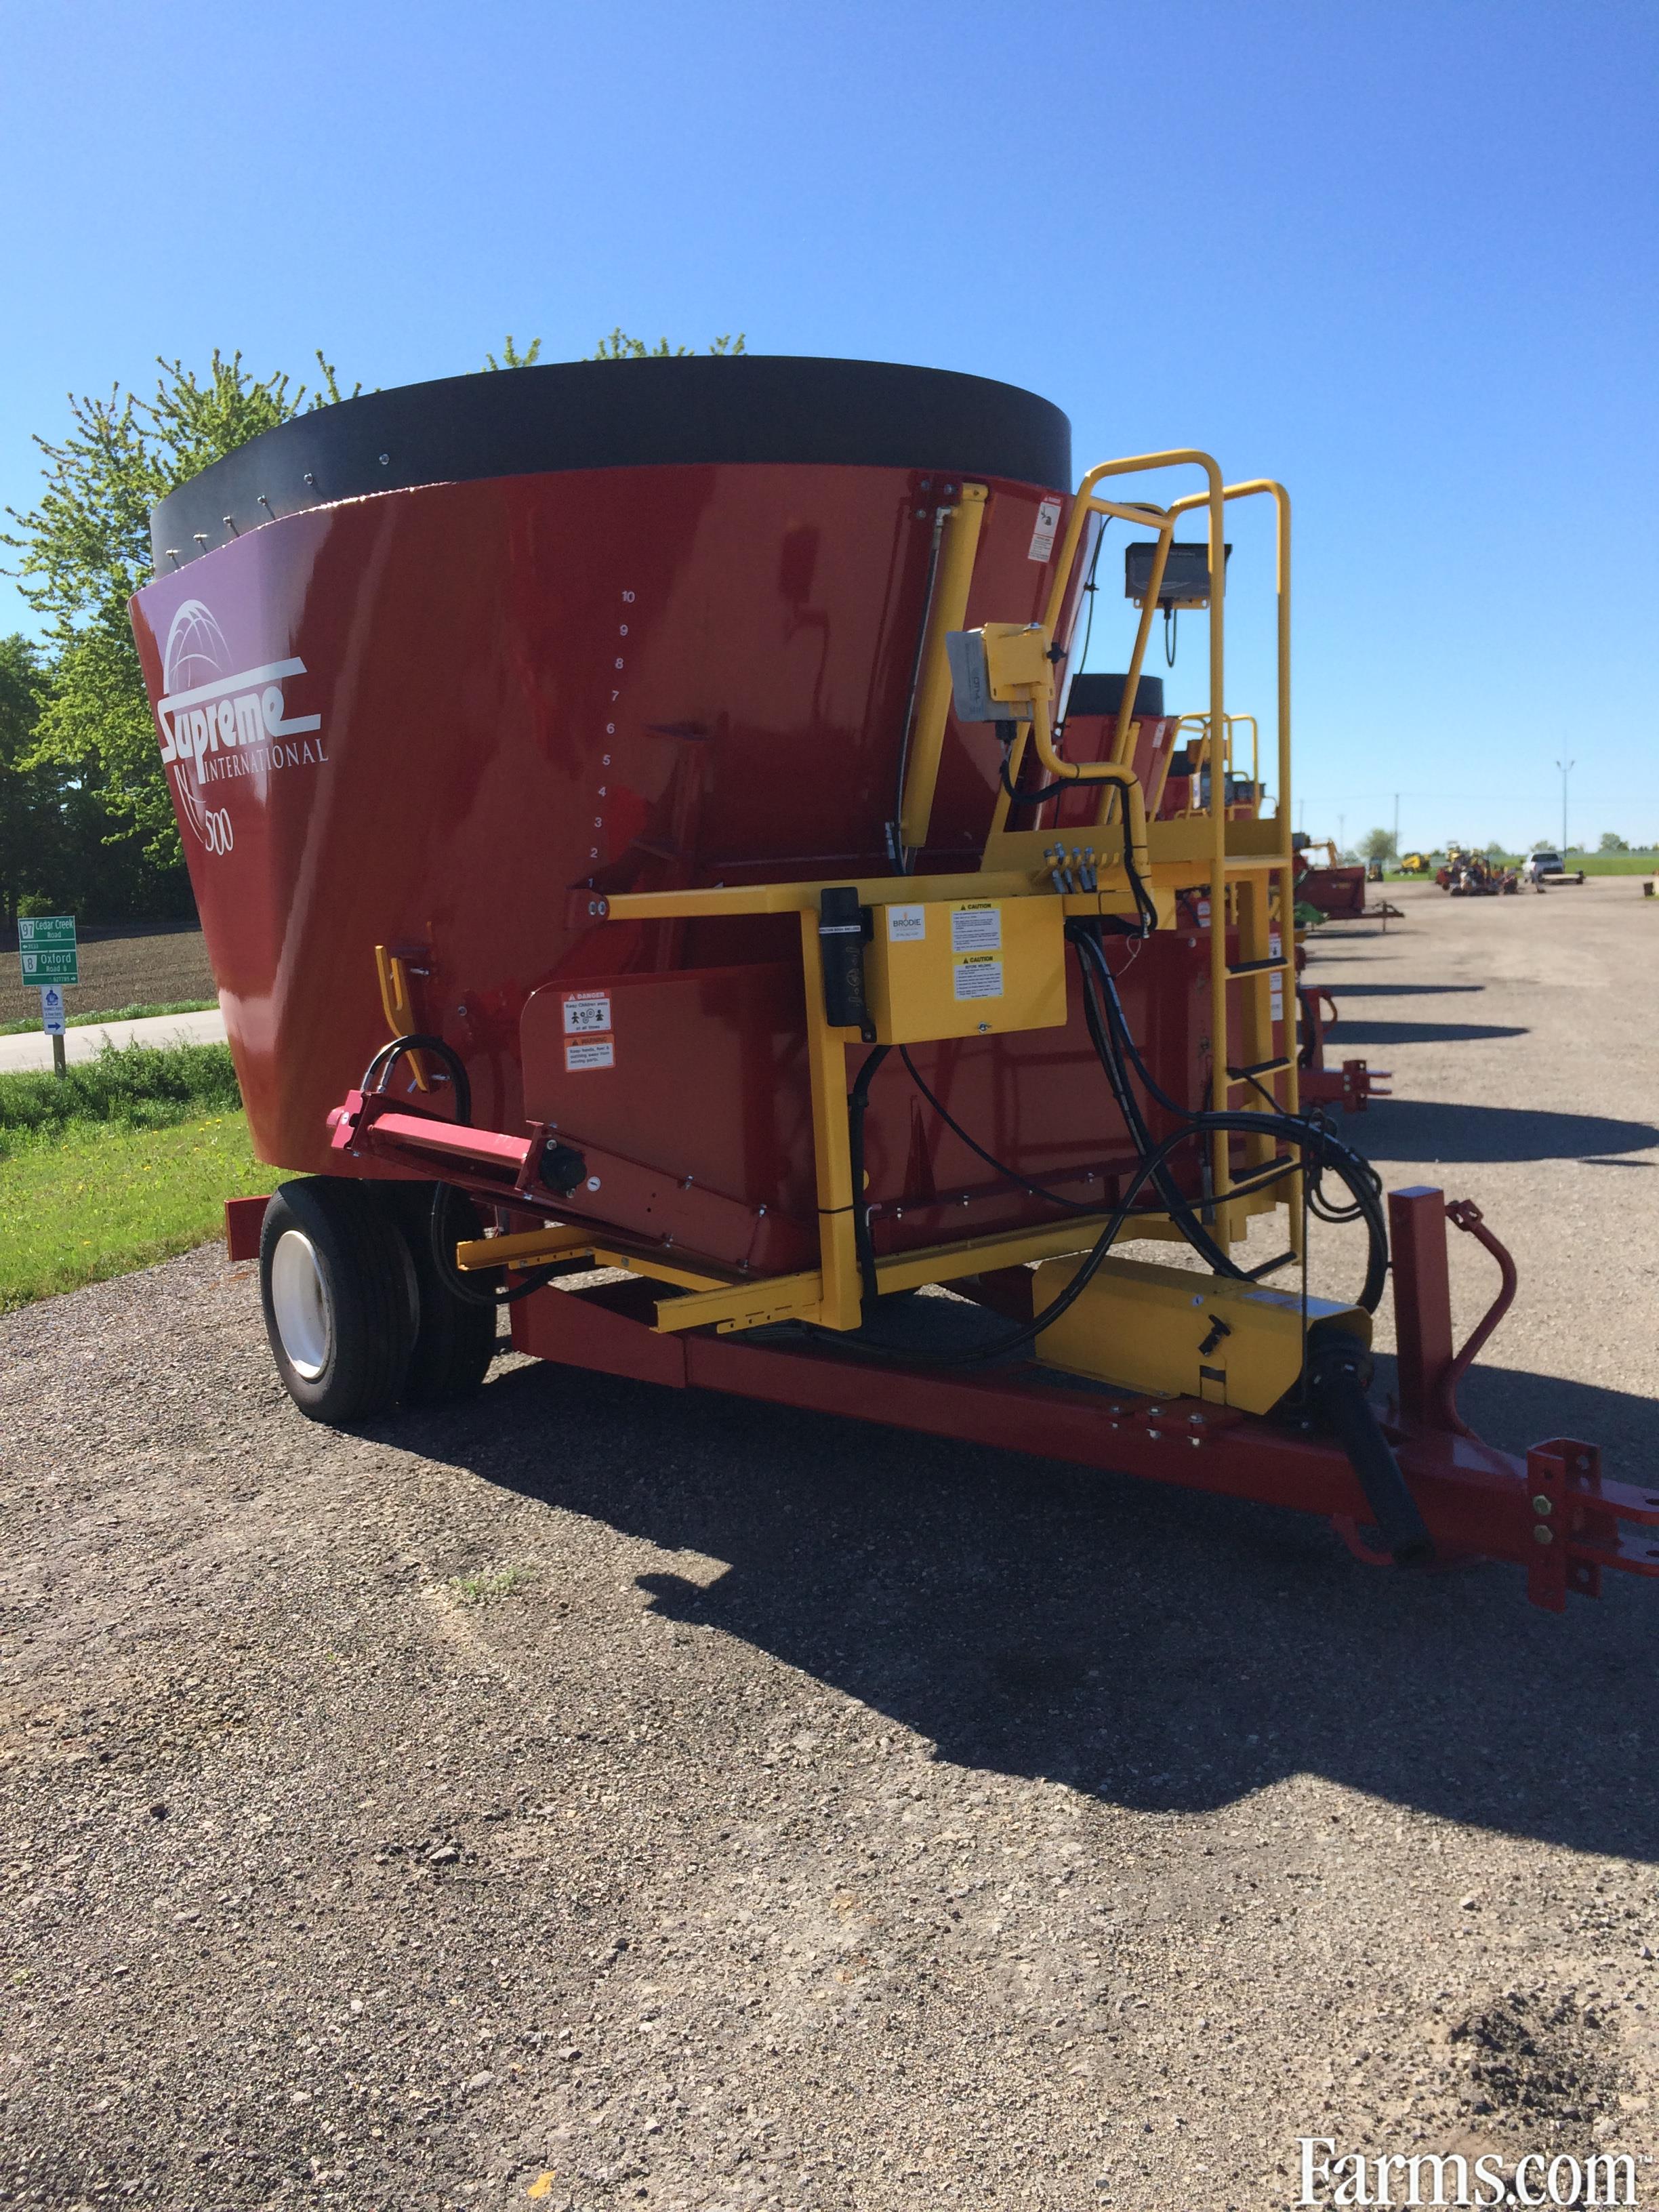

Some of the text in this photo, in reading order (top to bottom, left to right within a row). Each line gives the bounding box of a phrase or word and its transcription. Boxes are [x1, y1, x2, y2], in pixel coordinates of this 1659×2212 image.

[621, 590, 636, 603] 10
[619, 624, 629, 636] 9
[615, 657, 624, 670] 8
[612, 690, 619, 701] 7
[157, 656, 321, 785] Supreme
[607, 722, 615, 735] 6
[205, 738, 329, 783] INTERNATIONAL
[602, 754, 611, 766] 5
[598, 786, 607, 797] 4
[594, 817, 602, 828] 3
[205, 807, 234, 856] 500
[590, 847, 598, 859] 2
[22, 918, 74, 937] 97 Cedar Creek
[893, 918, 922, 928] BRODIE
[27, 953, 71, 970] 8 Oxford
[46, 964, 60, 972] Road
